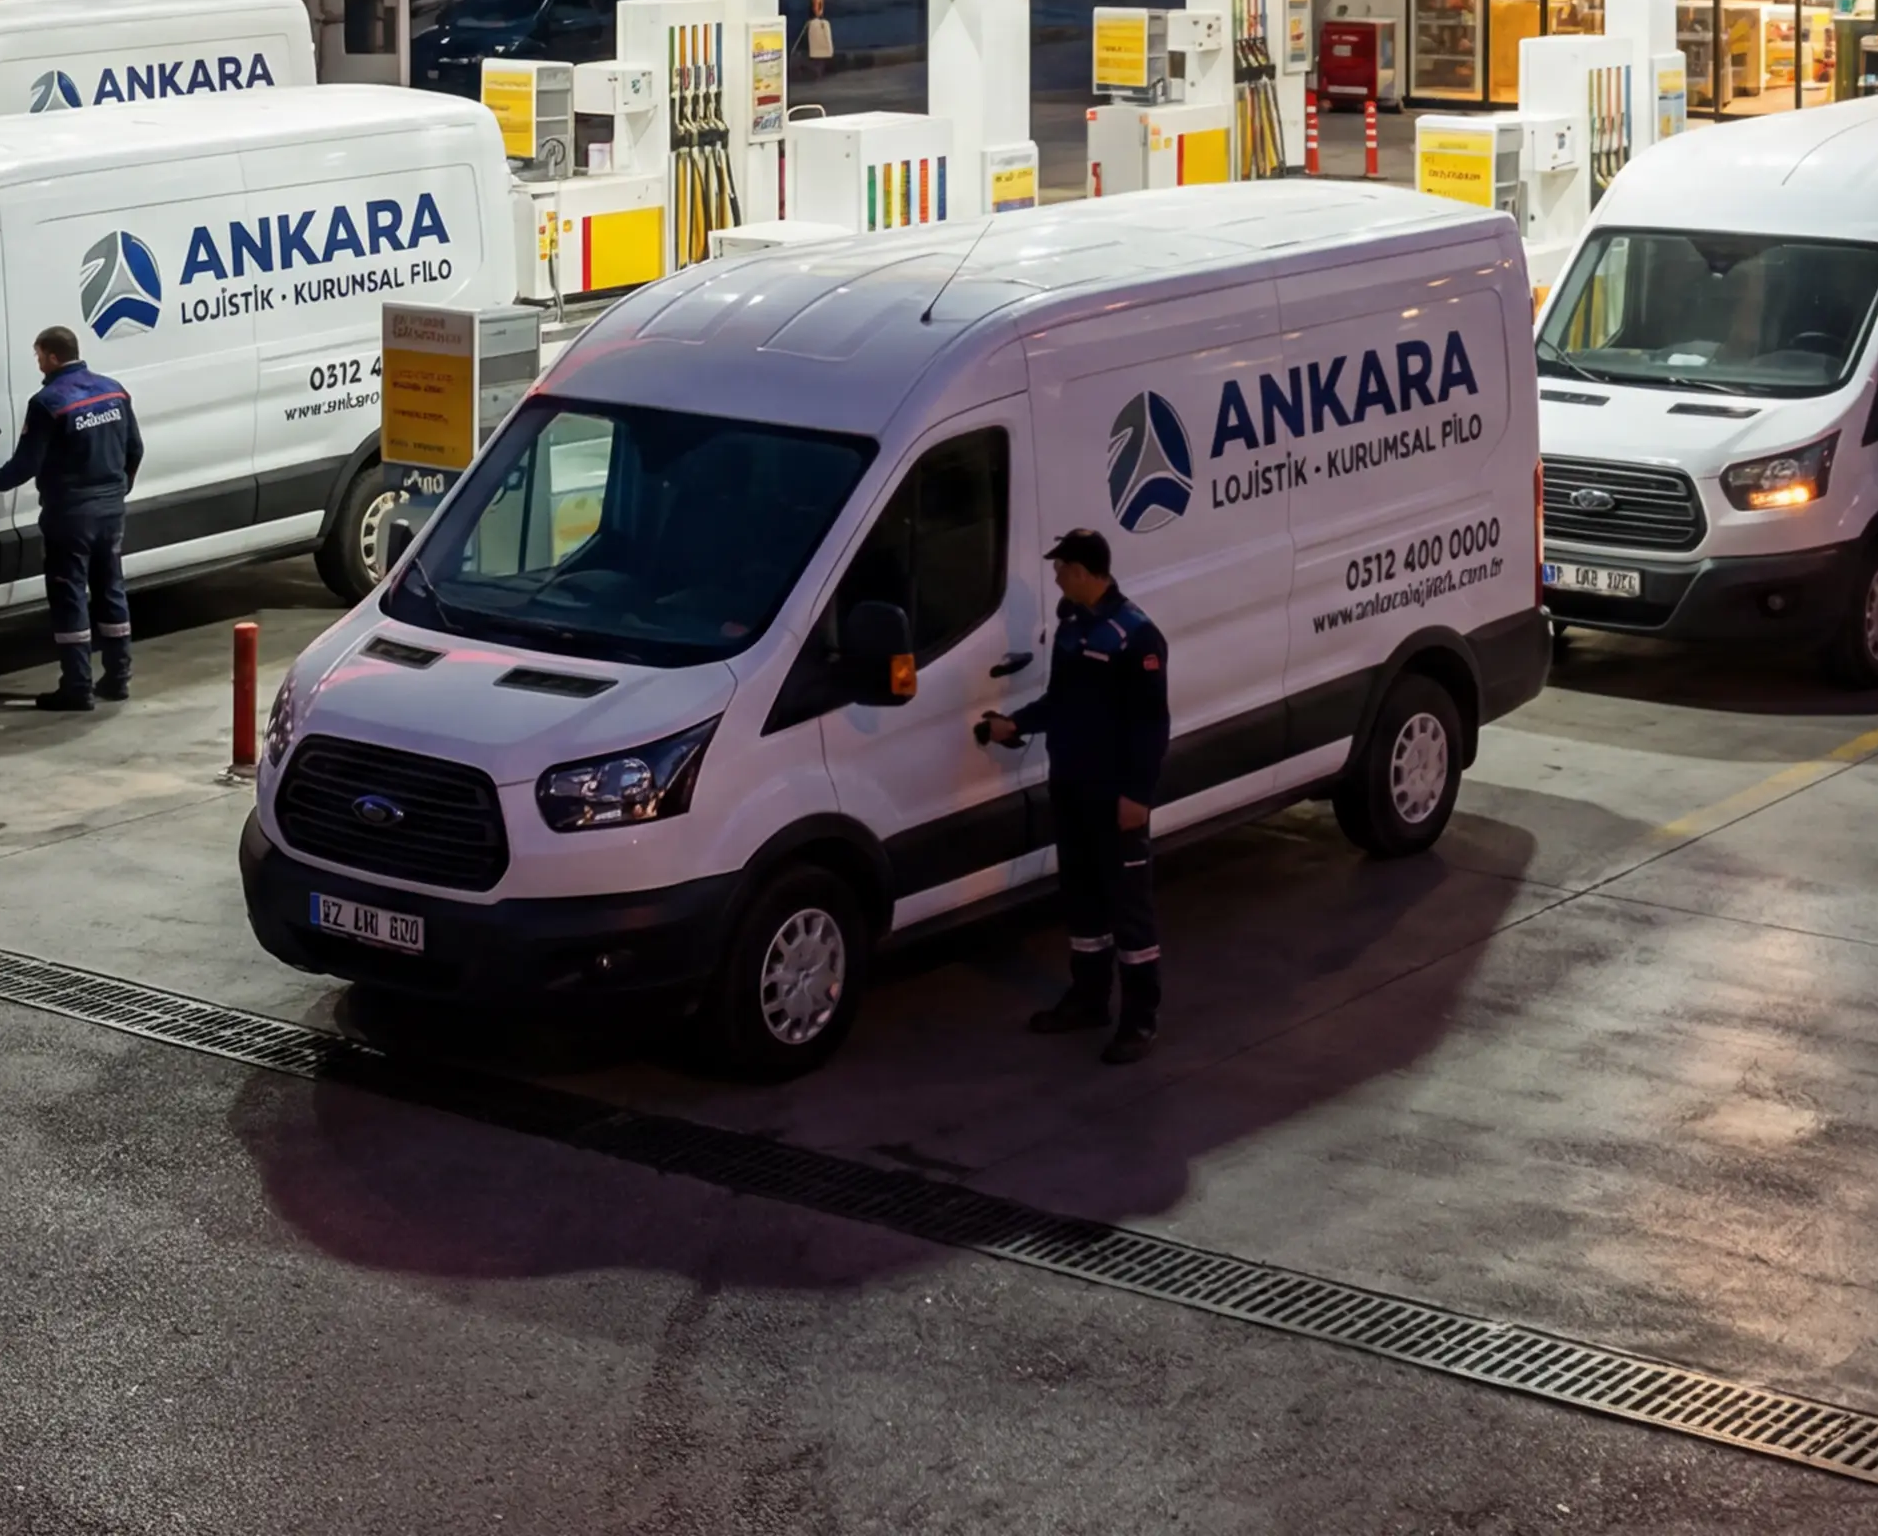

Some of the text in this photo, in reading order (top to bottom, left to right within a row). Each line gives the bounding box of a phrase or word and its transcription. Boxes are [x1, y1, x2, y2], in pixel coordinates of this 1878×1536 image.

[93, 53, 275, 105] ANKARA
[179, 193, 450, 285] ANKARA
[1210, 330, 1478, 459] ANKARA
[1403, 535, 1443, 573] 400
[1449, 517, 1500, 560] 0000
